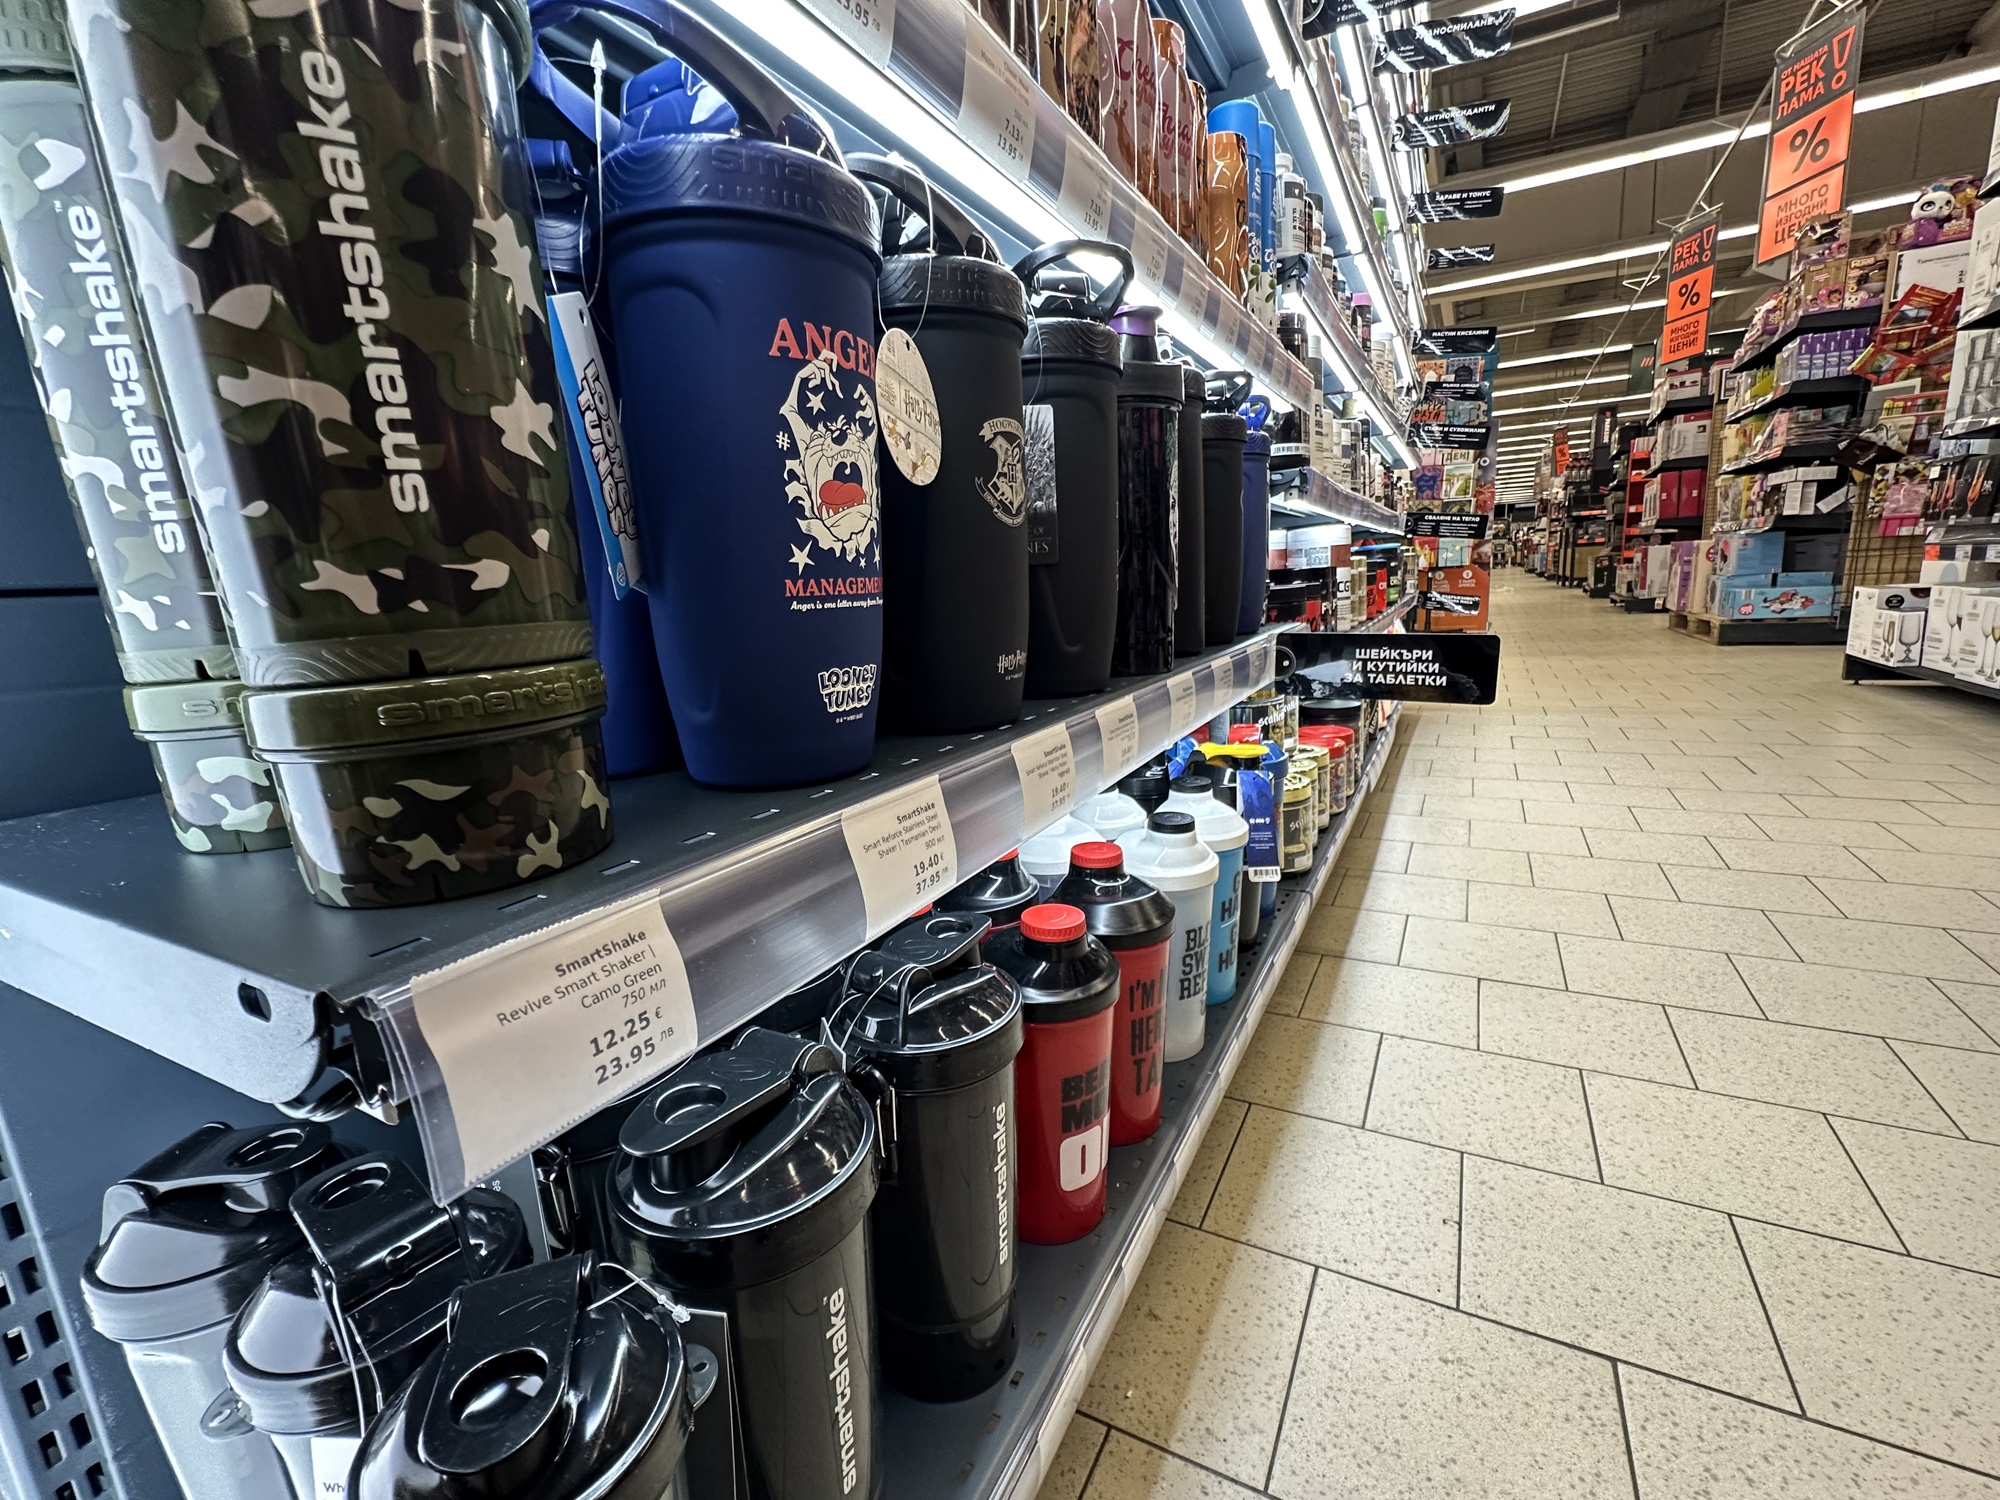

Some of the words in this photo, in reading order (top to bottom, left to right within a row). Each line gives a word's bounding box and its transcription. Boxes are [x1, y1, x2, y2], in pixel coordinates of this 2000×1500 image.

[1781, 66, 1793, 80] ОТ
[1793, 44, 1829, 73] НАШАТА
[1779, 53, 1829, 103] РЕК
[1423, 103, 1496, 123] АНТИОКСИДАНТИ
[1776, 80, 1825, 121] ЛАМА
[1004, 117, 1020, 142] 7.13
[997, 133, 1017, 160] 13.95
[1775, 197, 1829, 230] ИЗГОДНИ
[1776, 183, 1829, 218] МНОГО
[1672, 254, 1699, 274] ЛАМА
[1674, 238, 1700, 263] РЕК
[295, 49, 431, 514] smartshake
[1670, 319, 1700, 337] МНОГО
[1669, 336, 1698, 354] ЦЕНИ!
[67, 204, 187, 555] smartshake
[790, 600, 815, 612] Anger
[816, 600, 823, 610] is
[824, 602, 836, 610] one
[836, 598, 852, 609] letter
[996, 654, 1016, 674] Harry
[1352, 660, 1363, 671] И
[1366, 660, 1440, 674] КУТИЙКИ
[1355, 646, 1434, 661] ШЕЙКЪРИ
[818, 664, 877, 694] LOONEY
[1343, 672, 1364, 684] ЗА
[1367, 673, 1448, 687] ТАБЛЕТКИ
[821, 684, 873, 713] TUNES
[1043, 743, 1066, 758] SmartShake
[1051, 782, 1067, 799] 19.40
[896, 801, 936, 825] SmartShake
[863, 839, 882, 854] Smart
[881, 829, 903, 844] Reforce
[902, 818, 926, 835] Stainless
[925, 811, 939, 824] Steel
[878, 844, 898, 859] Shaker
[901, 827, 929, 847] Tasmanian
[928, 821, 942, 834] Devil
[925, 840, 937, 851] 900
[913, 853, 940, 878] 19.40
[916, 870, 941, 895] 37.95
[554, 929, 647, 978] SmartShake
[496, 993, 553, 1027] Revive
[554, 970, 601, 1001] Smart
[600, 948, 647, 979] Shaker
[580, 982, 622, 1010] Camo
[623, 962, 663, 989] Green
[621, 986, 646, 1009] 750
[649, 978, 667, 995] мл
[589, 1009, 651, 1058] 12.25
[654, 1006, 664, 1020] €
[594, 1036, 656, 1086] 23.95
[659, 1026, 675, 1043] лв
[993, 1101, 1009, 1266] smartshake
[824, 1286, 858, 1496] smartshake
